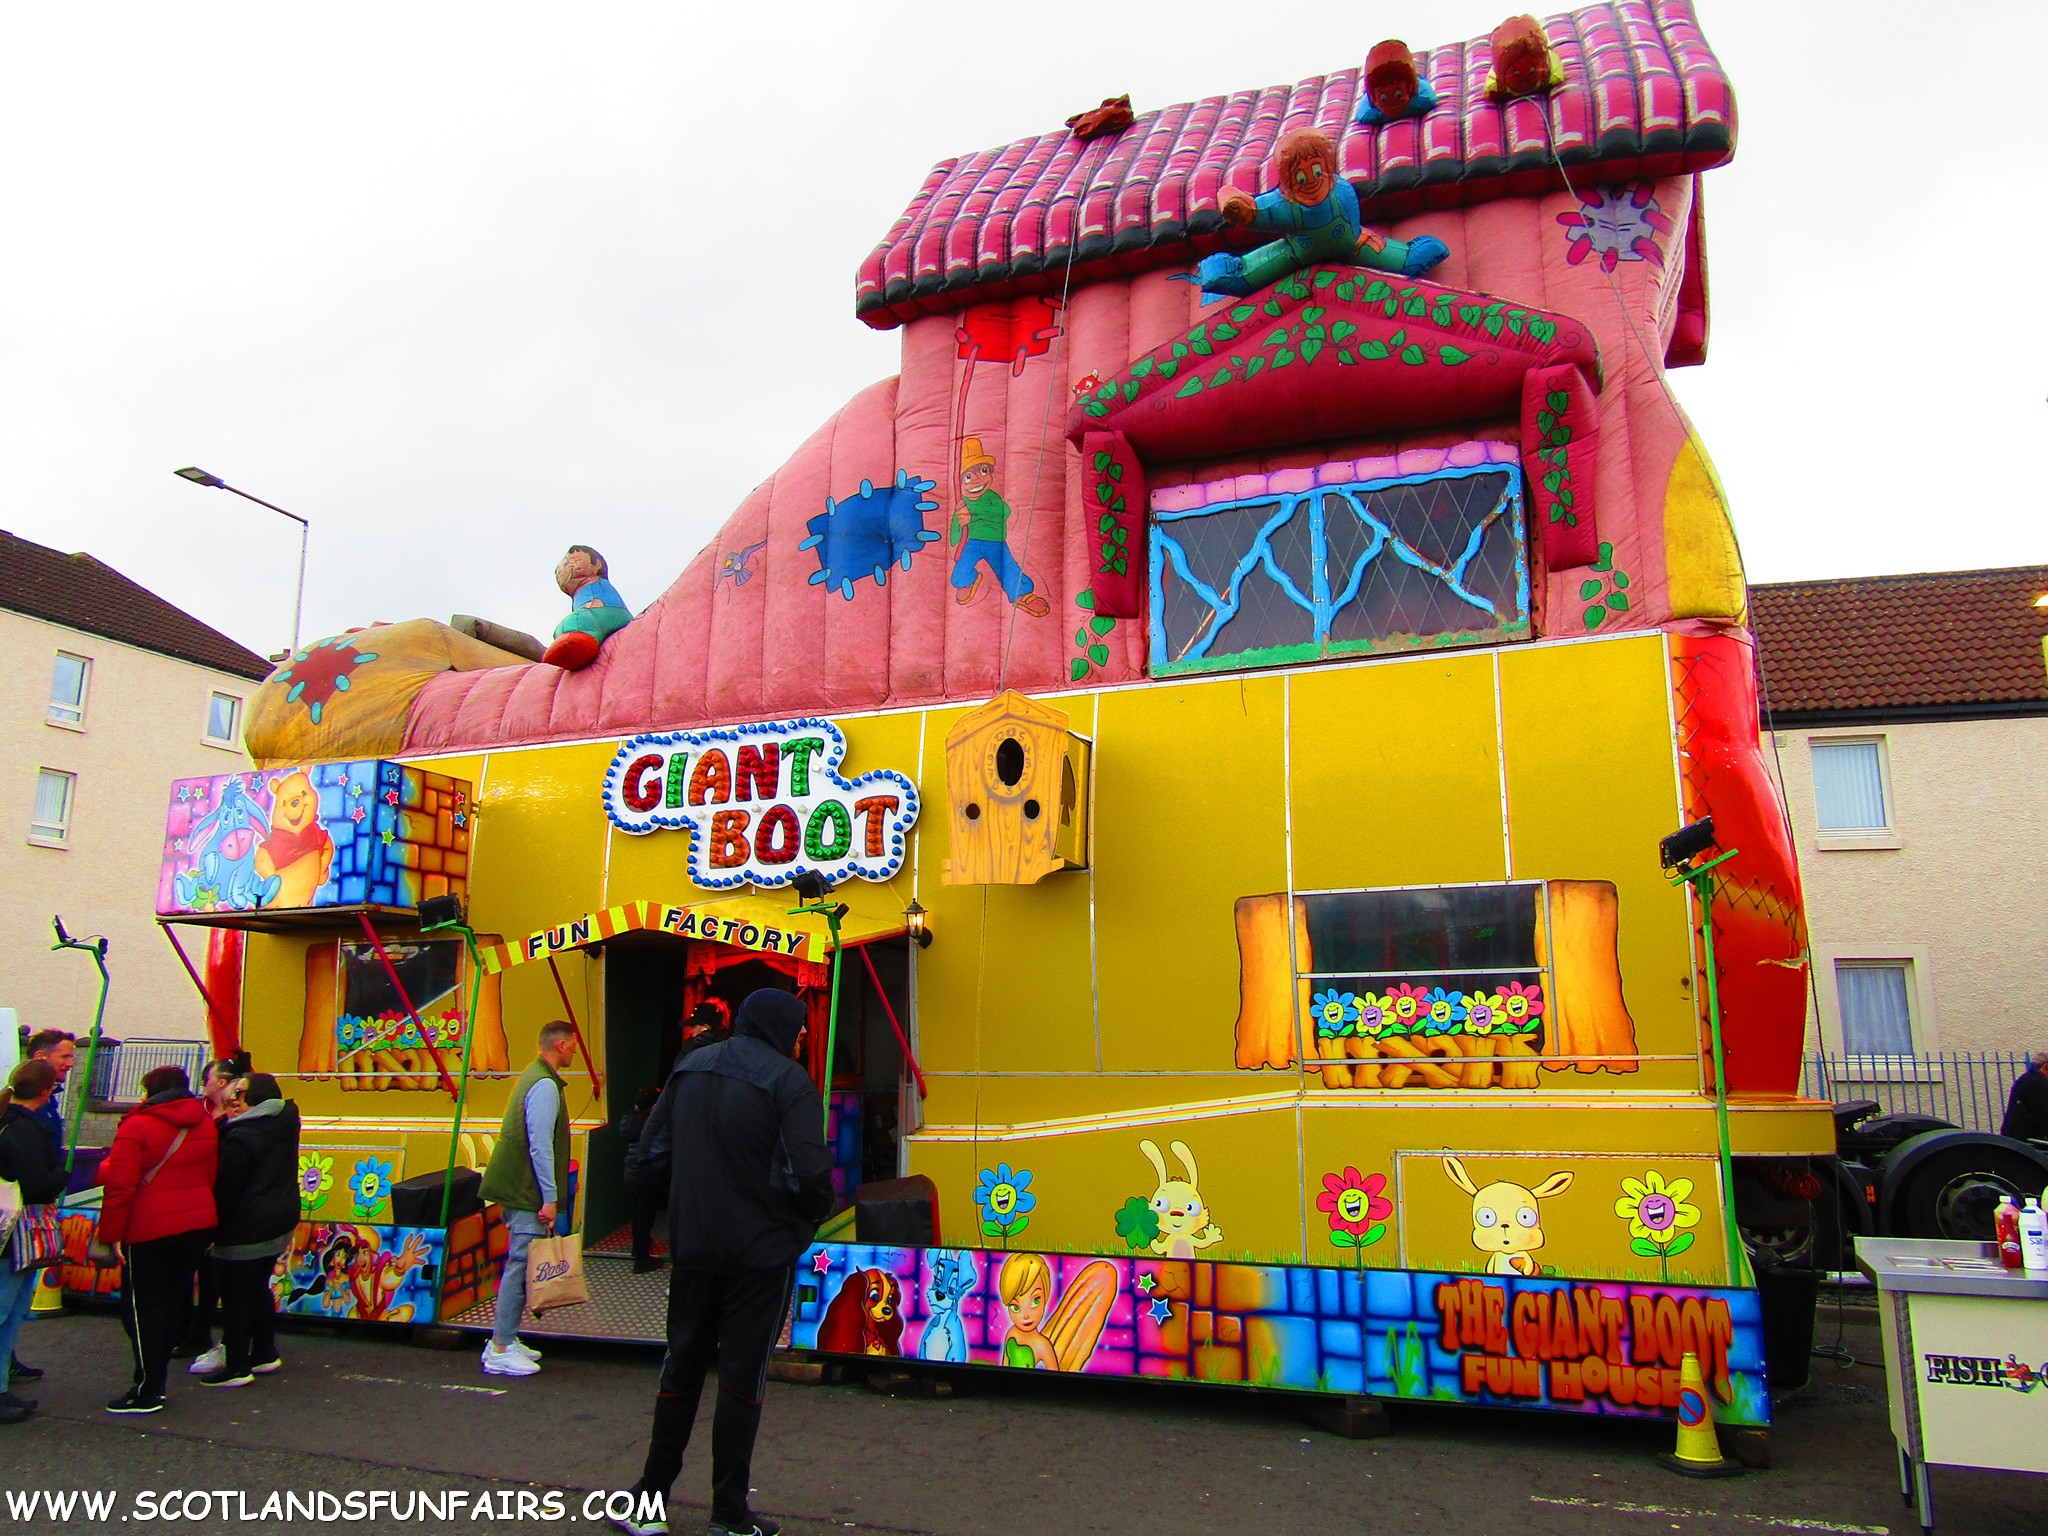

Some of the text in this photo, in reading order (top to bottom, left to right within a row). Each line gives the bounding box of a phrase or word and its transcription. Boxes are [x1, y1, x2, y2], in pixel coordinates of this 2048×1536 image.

[622, 736, 825, 813] GIANT
[1024, 757, 1032, 769] 3
[708, 795, 900, 869] BOOT
[528, 909, 804, 959] FUN FACTORY
[1438, 1279, 1733, 1404] THE GIANT BOOT
[1463, 1354, 1681, 1407] FUN HOUSE
[1925, 1354, 2004, 1388] FISH
